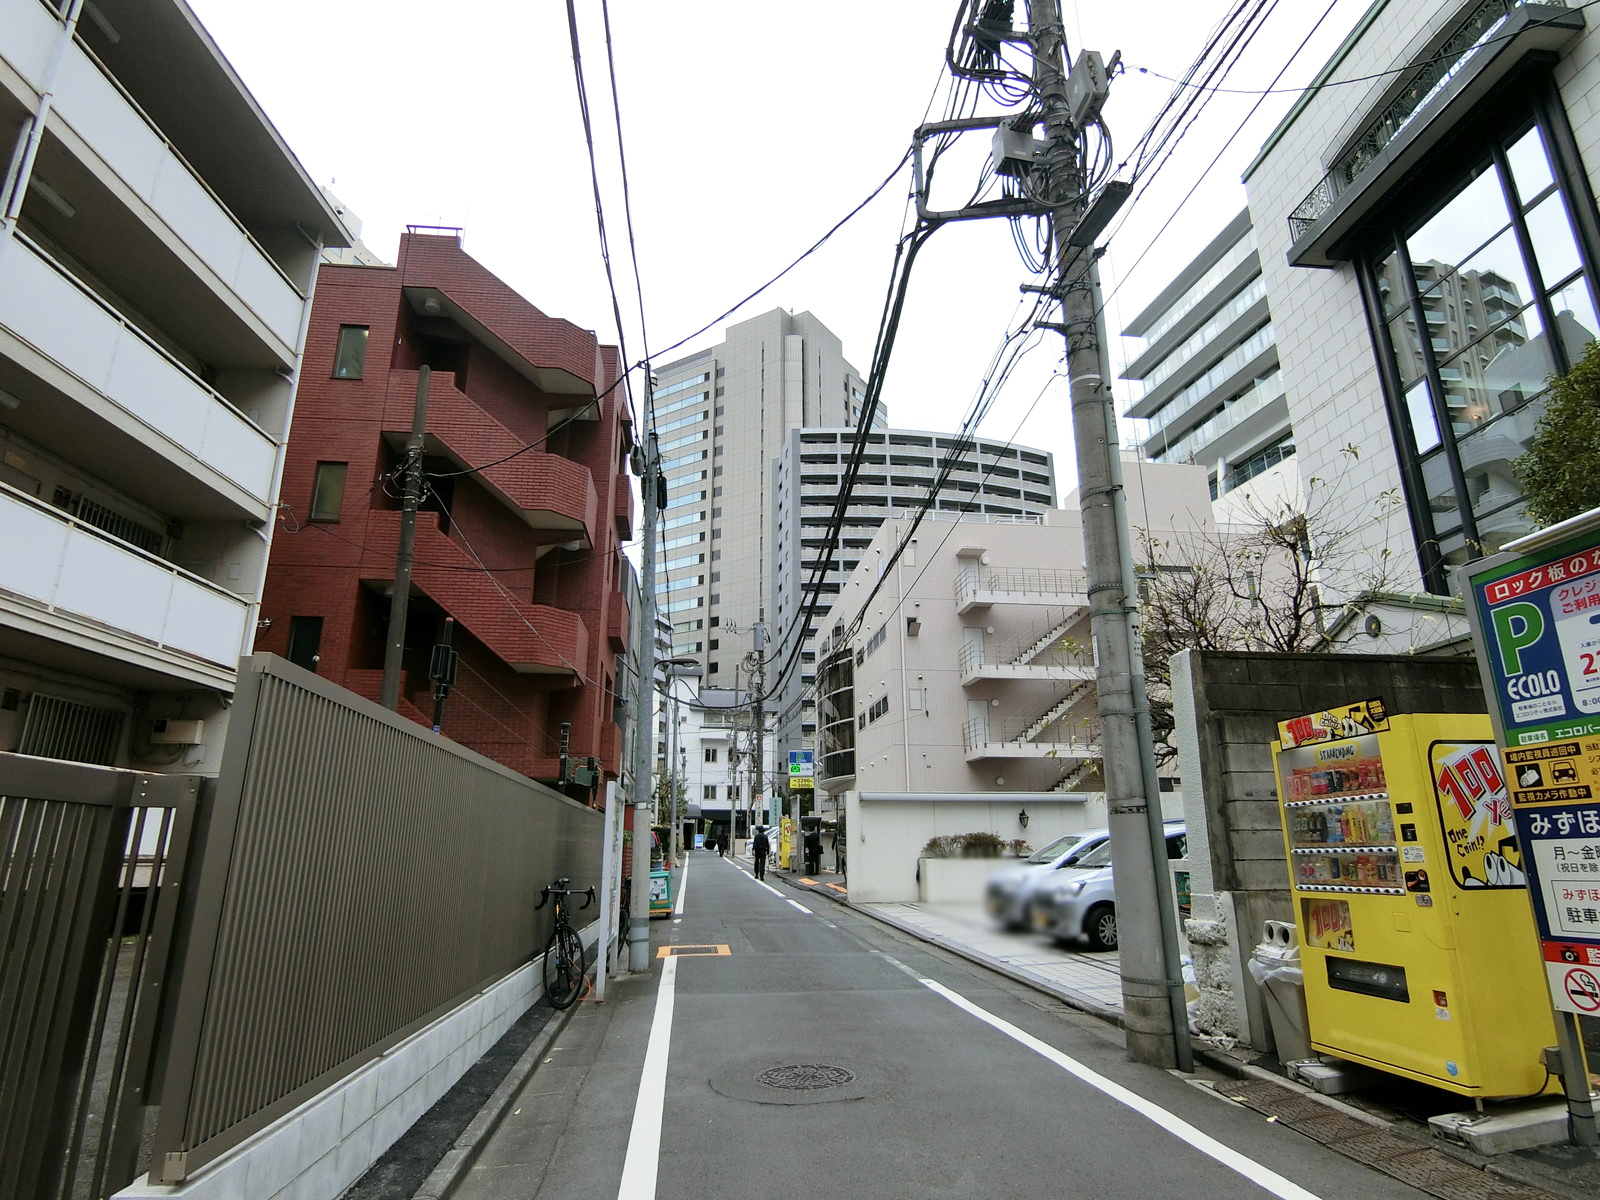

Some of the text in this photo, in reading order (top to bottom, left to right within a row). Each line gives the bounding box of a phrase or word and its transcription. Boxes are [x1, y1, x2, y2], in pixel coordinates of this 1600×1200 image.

[1491, 602, 1544, 677] P
[1507, 670, 1561, 700] ECOLO
[1437, 746, 1504, 822] 100
[1518, 788, 1587, 802] 監視カメラ作動中
